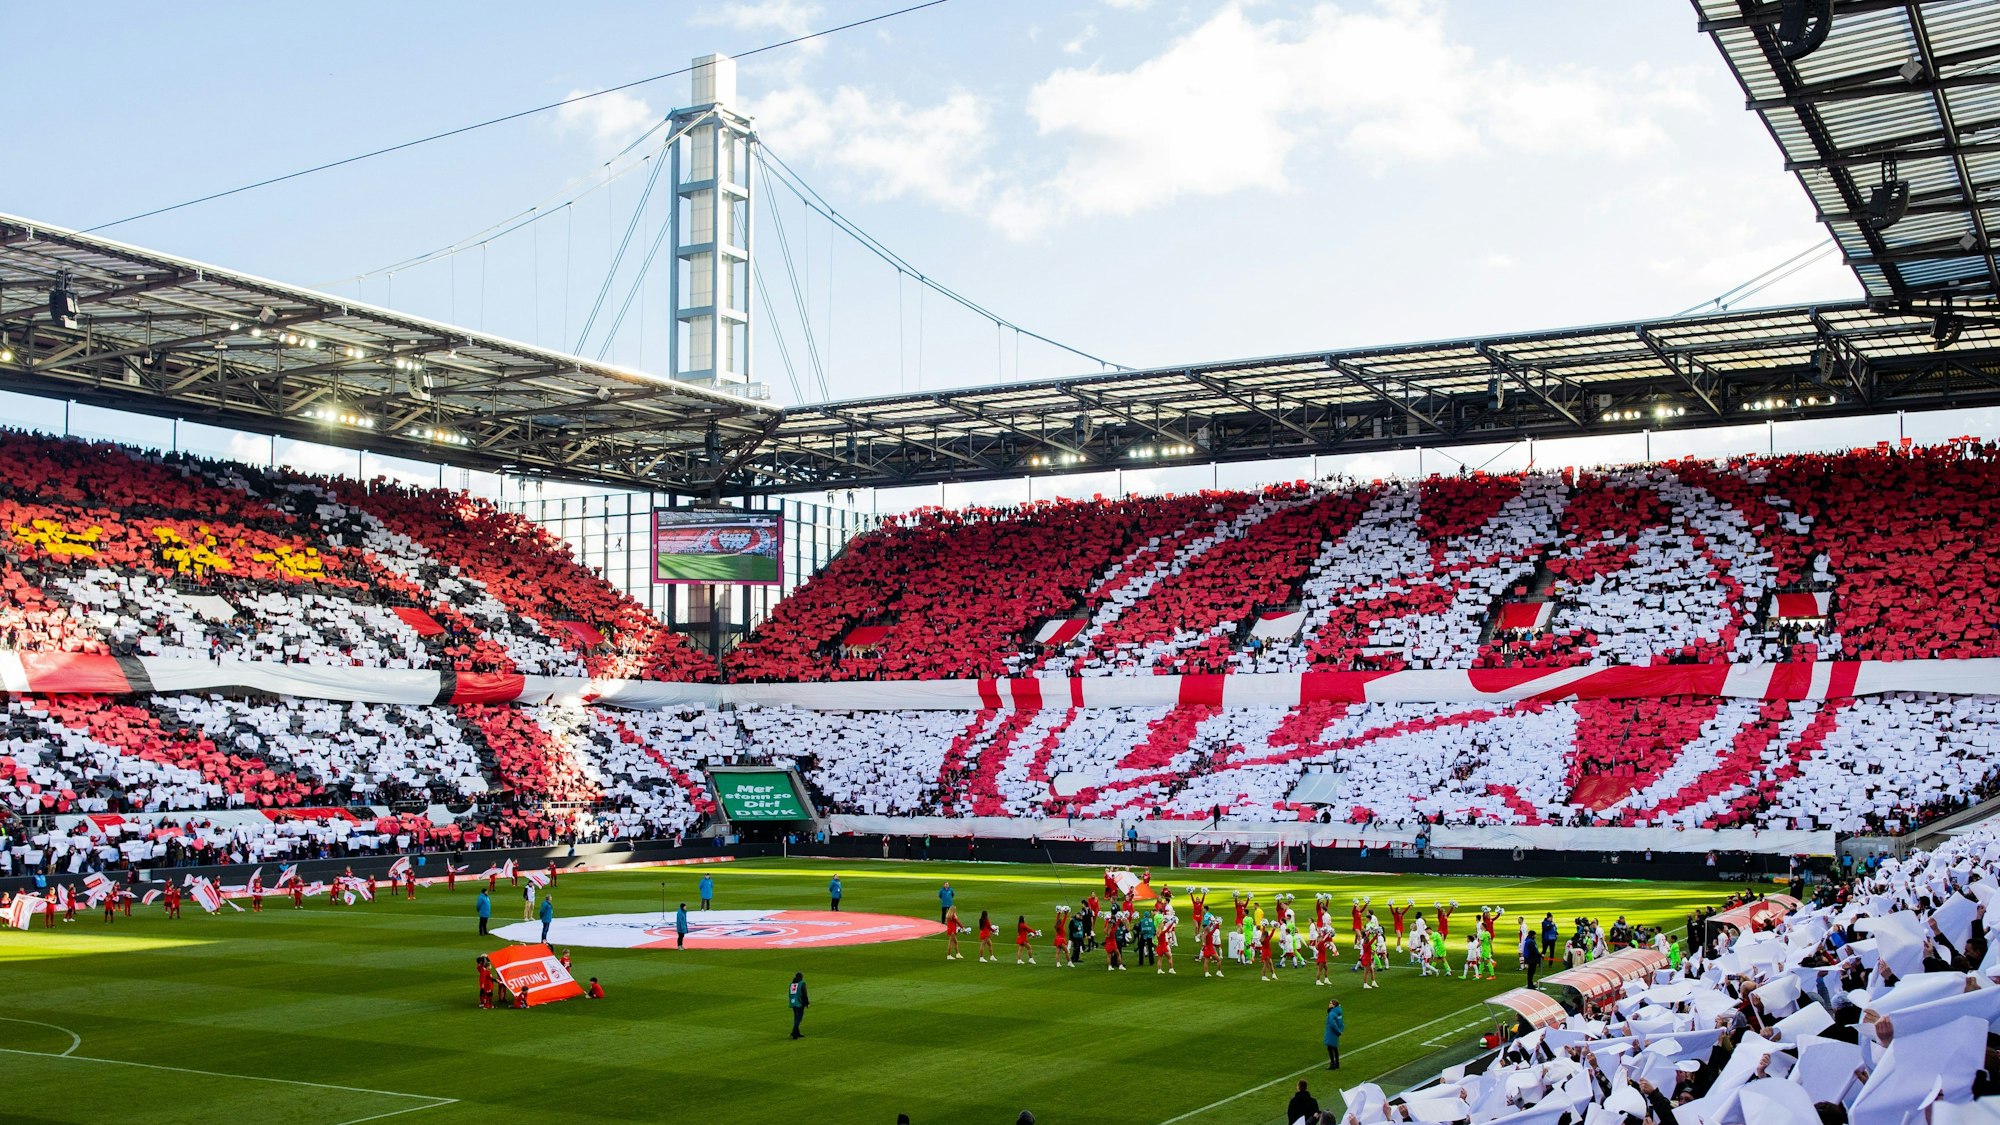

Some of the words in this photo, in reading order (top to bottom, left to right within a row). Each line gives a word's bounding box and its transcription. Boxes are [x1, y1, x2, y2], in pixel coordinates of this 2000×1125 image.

[737, 785, 774, 793] Mer
[744, 800, 780, 808] Dir!
[508, 972, 547, 989] STIFTUNG
